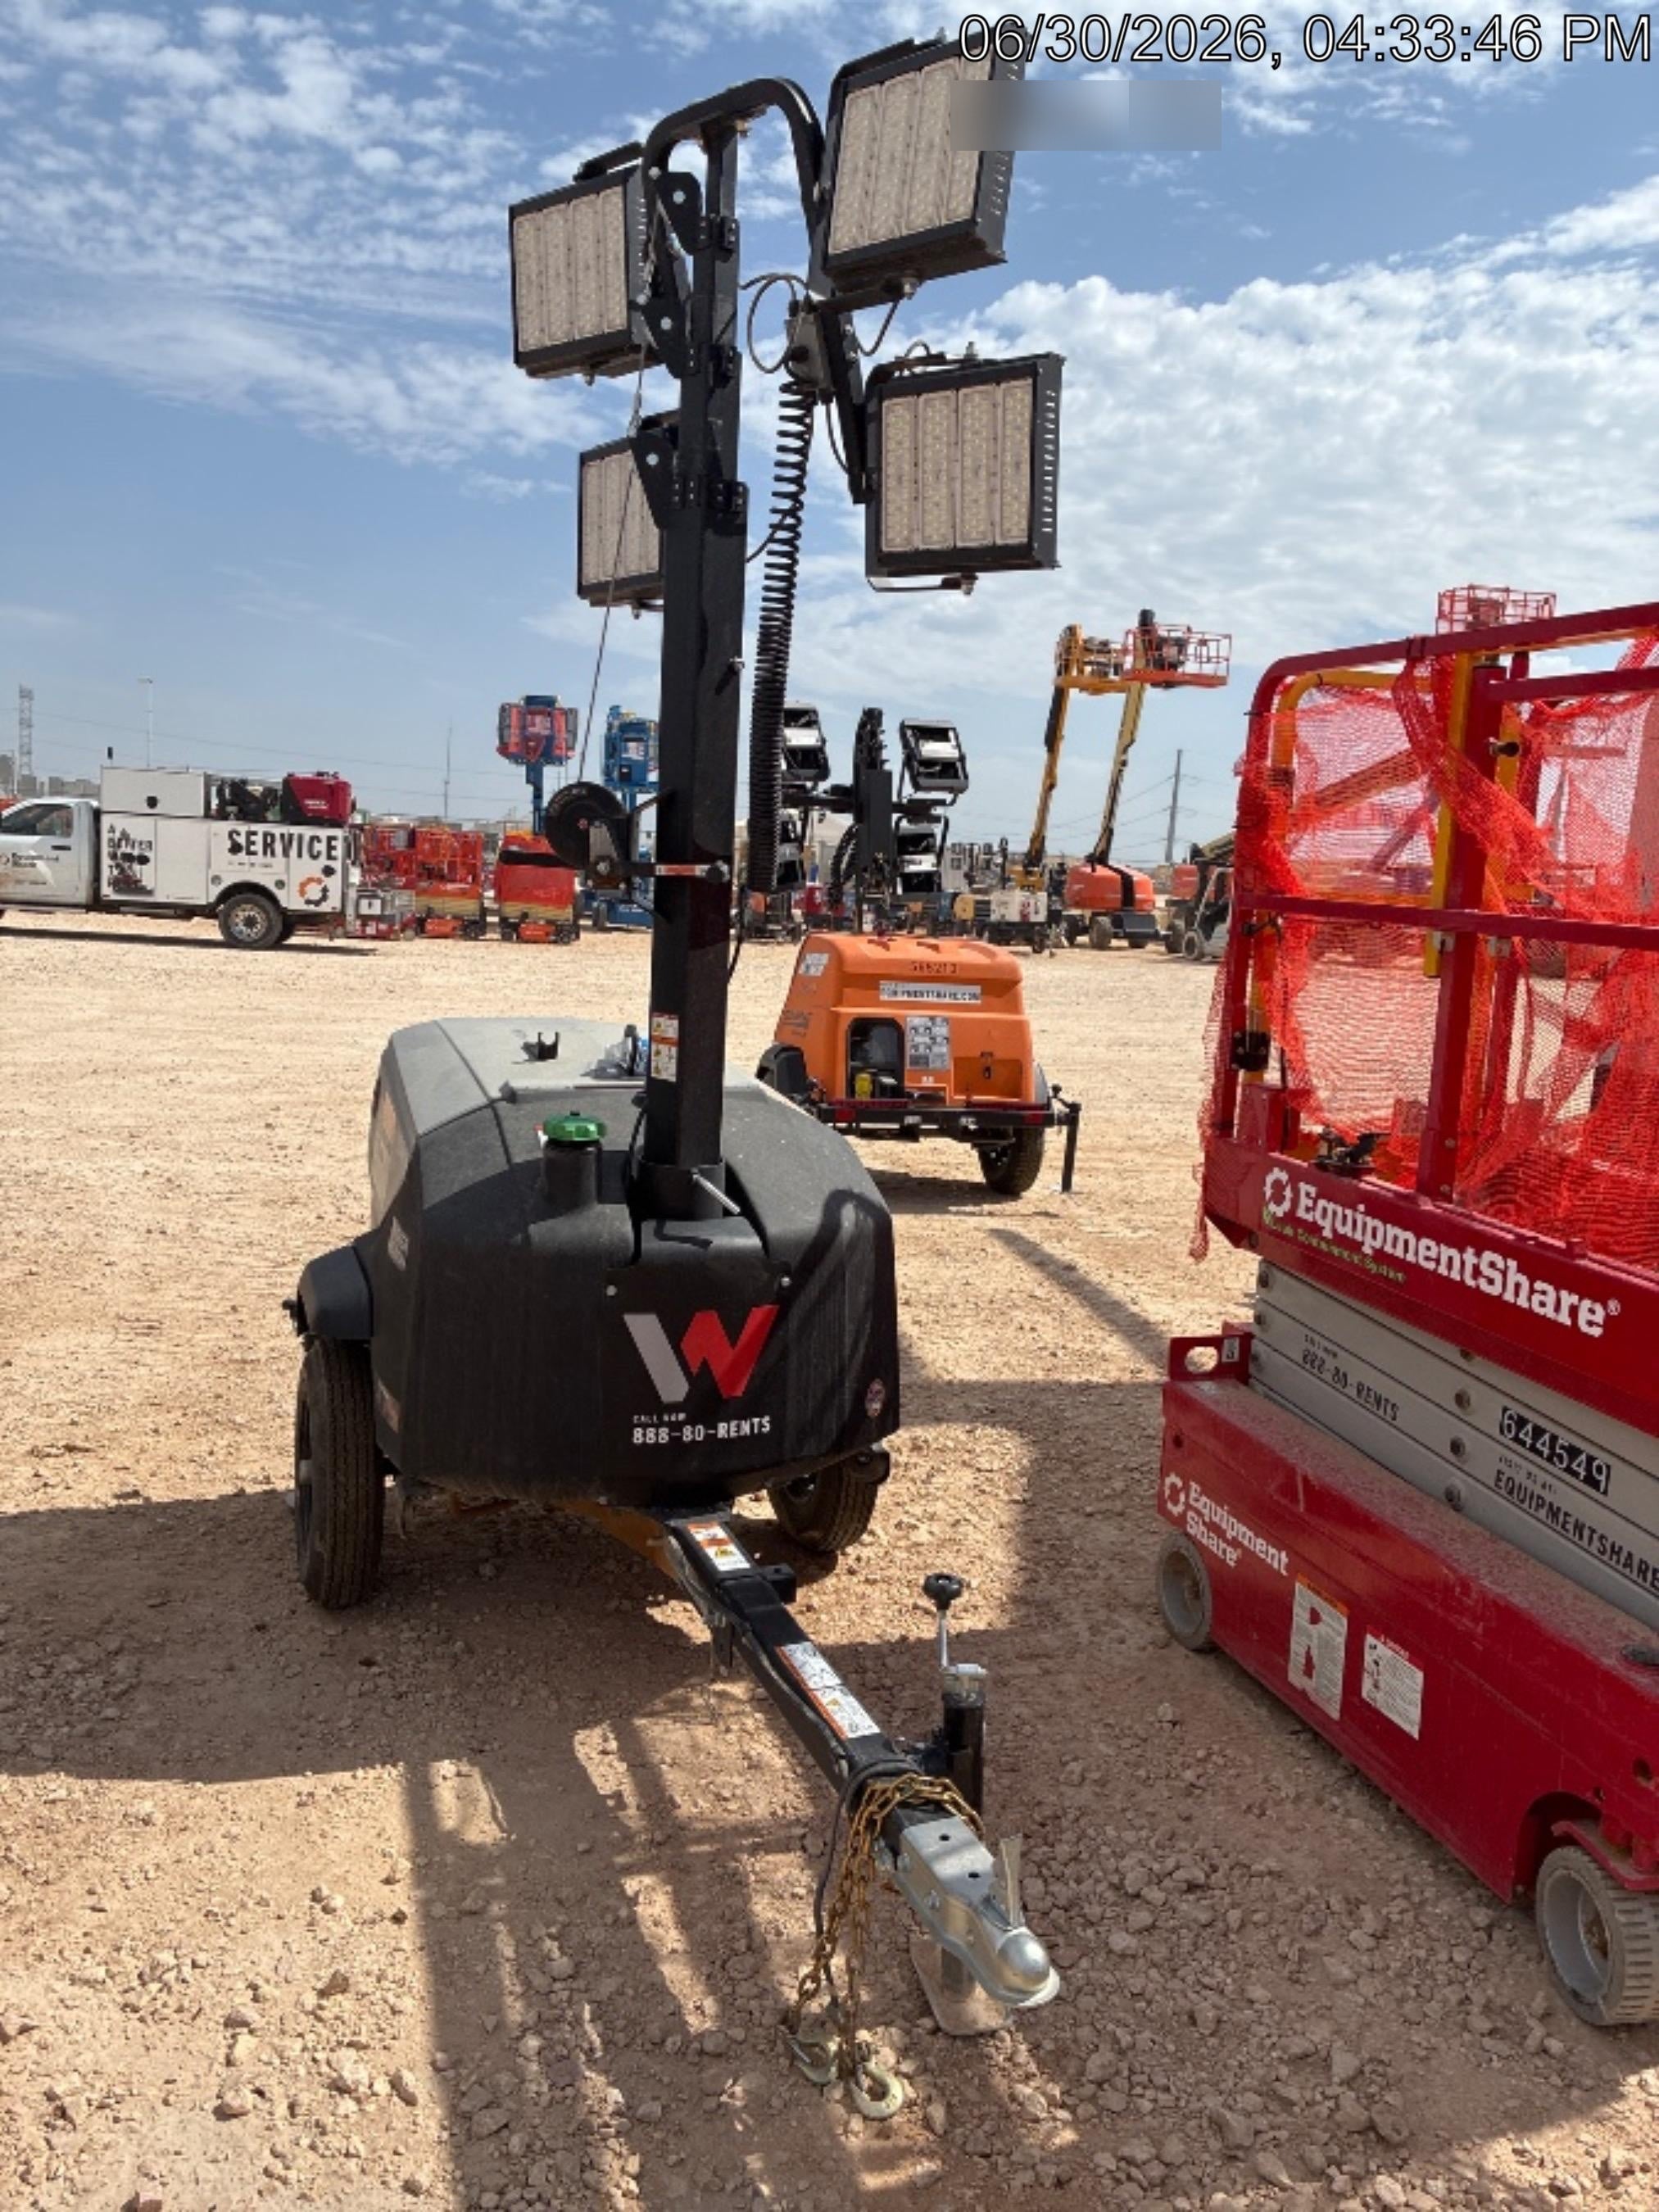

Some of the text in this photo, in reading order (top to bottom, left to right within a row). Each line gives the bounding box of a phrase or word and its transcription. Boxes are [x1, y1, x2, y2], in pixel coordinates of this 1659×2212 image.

[227, 827, 340, 861] SERVICE
[632, 1415, 771, 1444] 888-80-RENTS
[1502, 1408, 1607, 1494] 644549
[1189, 1480, 1290, 1577] Equipment
